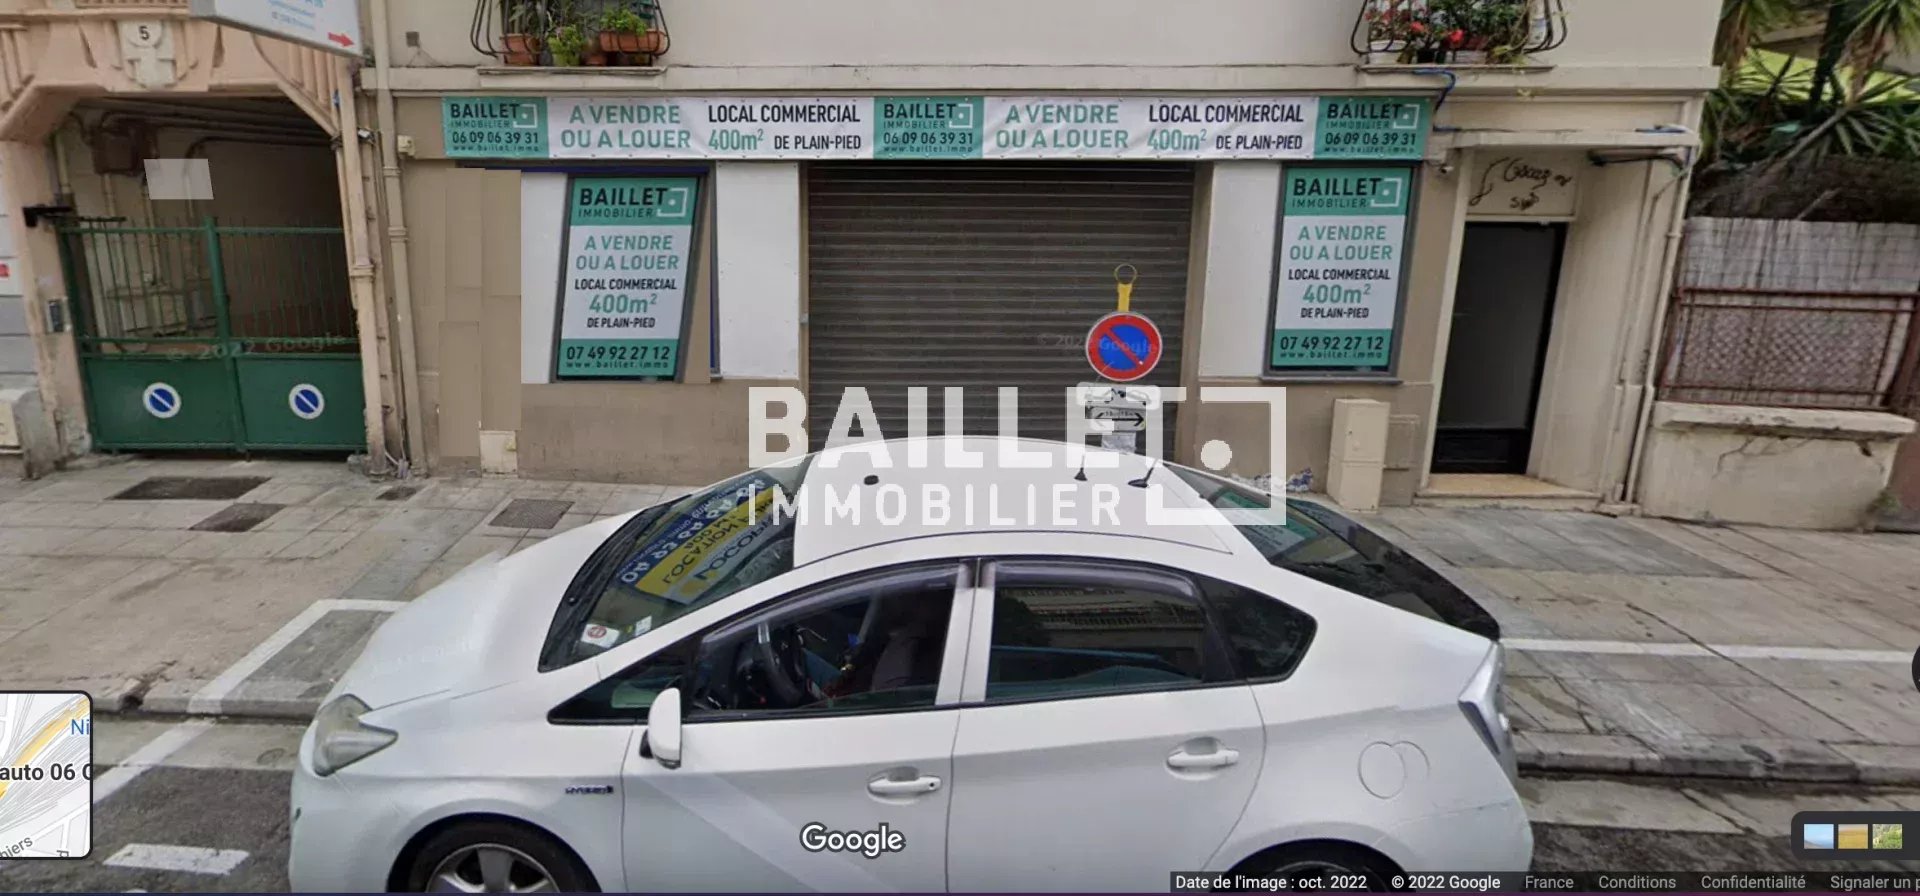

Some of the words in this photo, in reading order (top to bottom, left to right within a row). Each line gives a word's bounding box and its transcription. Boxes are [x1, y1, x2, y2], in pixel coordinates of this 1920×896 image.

[139, 25, 150, 41] 5
[451, 104, 521, 118] BAILLET
[570, 105, 585, 123] A
[589, 105, 680, 123] VENDRE
[709, 105, 757, 122] LOCAL
[761, 105, 860, 122] COMMERCIAL
[884, 104, 958, 118] BAILLET
[1006, 105, 1020, 123] A
[1026, 105, 1118, 123] VENDRE
[1149, 105, 1202, 122] LOCAL
[1205, 105, 1304, 122] COMMERCIAL
[1327, 104, 1403, 119] BAILLET
[451, 120, 510, 128] IMMOBILIER
[884, 121, 945, 129] IMMOBILIER
[1326, 121, 1389, 129] IMMOBILIER
[453, 132, 466, 144] 06
[470, 132, 484, 144] 09
[487, 132, 501, 144] 06
[505, 132, 521, 144] 39
[525, 132, 538, 144] 31
[561, 129, 591, 148] OU
[597, 129, 613, 148] A
[618, 129, 691, 148] LOUER
[774, 136, 790, 149] DE
[794, 136, 861, 149] PLAIN-PIED
[884, 132, 898, 144] 06
[902, 132, 917, 144] 09
[921, 132, 936, 144] 06
[940, 132, 955, 144] 39
[959, 132, 973, 144] 31
[996, 129, 1026, 148] OU
[1031, 129, 1047, 148] A
[1053, 129, 1128, 148] LOUER
[1216, 136, 1231, 149] DE
[1236, 136, 1302, 149] PLAIN-PIED
[1325, 133, 1340, 145] 06
[1344, 133, 1358, 145] 09
[1362, 133, 1378, 145] 06
[1381, 133, 1397, 145] 39
[1401, 133, 1416, 145] 31
[1293, 178, 1382, 195] BAILLET
[580, 188, 668, 205] BAILLET
[1292, 198, 1367, 208] IMMOBILIER
[579, 208, 653, 218] IMMOBILIER
[1298, 226, 1310, 240] A
[1315, 226, 1387, 240] VENDRE
[584, 235, 596, 250] A
[601, 235, 673, 250] VENDRE
[1290, 245, 1313, 260] OU
[1318, 245, 1329, 260] A
[1335, 245, 1393, 260] LOUER
[576, 255, 599, 270] OU
[604, 255, 616, 270] A
[621, 255, 679, 270] LOUER
[1288, 269, 1320, 280] LOCAL
[1322, 269, 1391, 280] COMMERCIAL
[575, 279, 607, 290] LOCAL
[609, 279, 677, 290] COMMERCIAL
[1301, 307, 1313, 318] DE
[1315, 307, 1369, 318] PLAIN-PIED
[587, 317, 600, 328] DE
[601, 317, 656, 328] PLAIN-PIED
[1280, 336, 1298, 350] 07
[1301, 336, 1319, 350] 49
[1323, 336, 1340, 350] 92
[1344, 336, 1362, 350] 27
[1367, 336, 1384, 350] 12
[566, 346, 584, 360] 07
[588, 346, 605, 360] 49
[609, 346, 627, 360] 92
[630, 346, 648, 360] 27
[653, 346, 670, 360] 12
